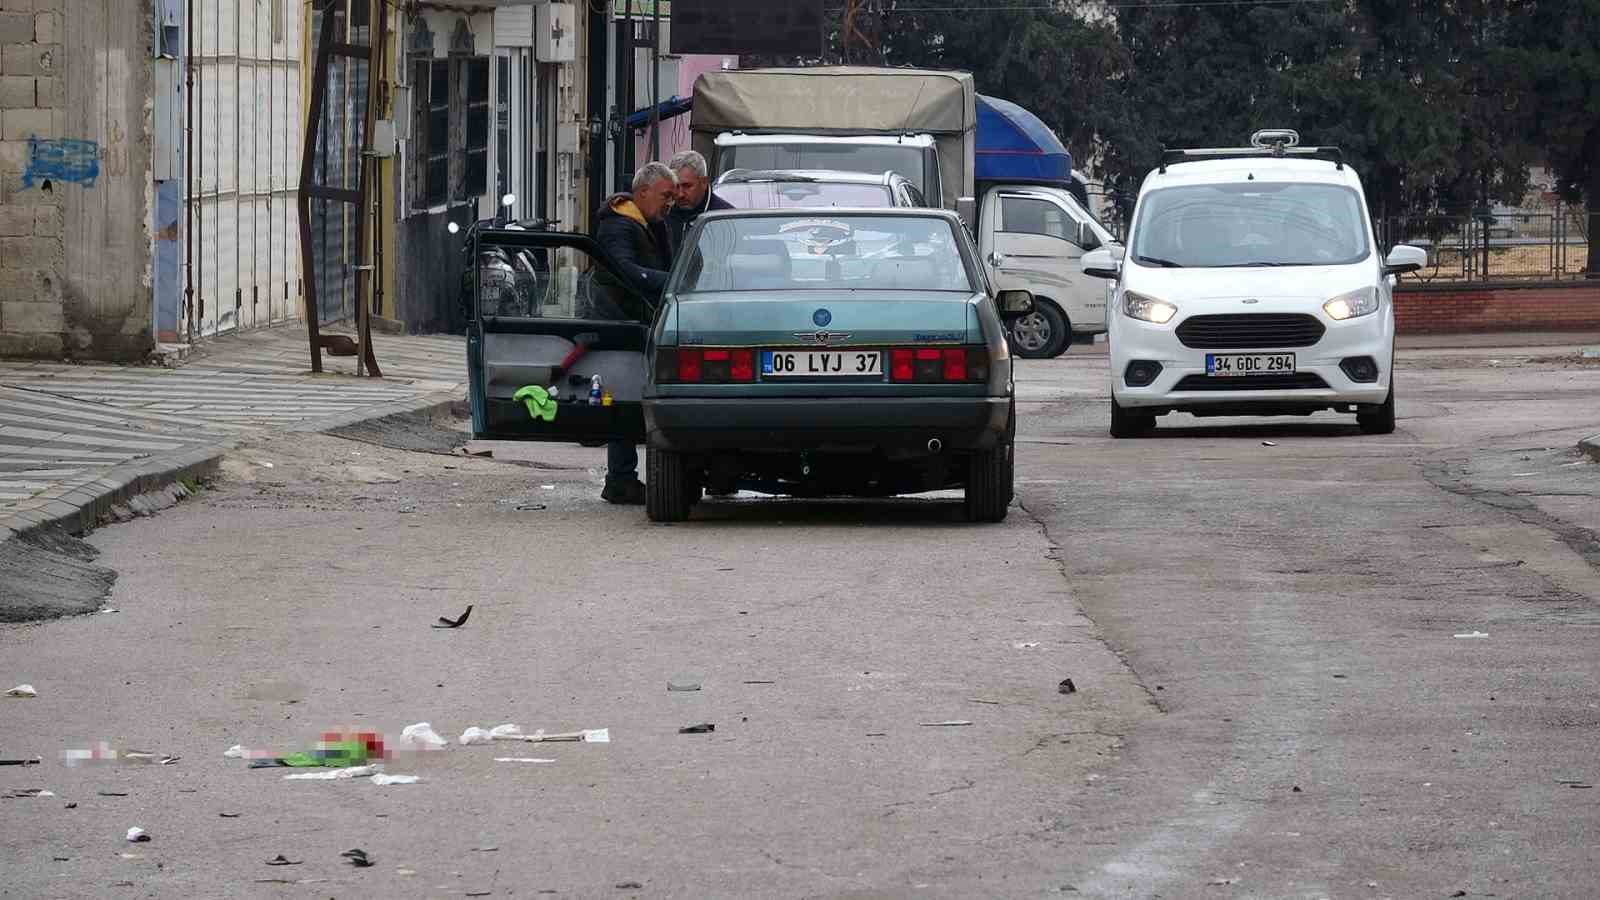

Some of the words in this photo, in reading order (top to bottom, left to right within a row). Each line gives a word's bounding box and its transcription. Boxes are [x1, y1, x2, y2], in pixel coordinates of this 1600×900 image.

[774, 354, 795, 372] 06
[808, 354, 842, 372] LYJ
[856, 354, 877, 372] 37
[1215, 358, 1231, 370] 34
[1237, 357, 1261, 370] GDC
[1267, 356, 1292, 370] 294
